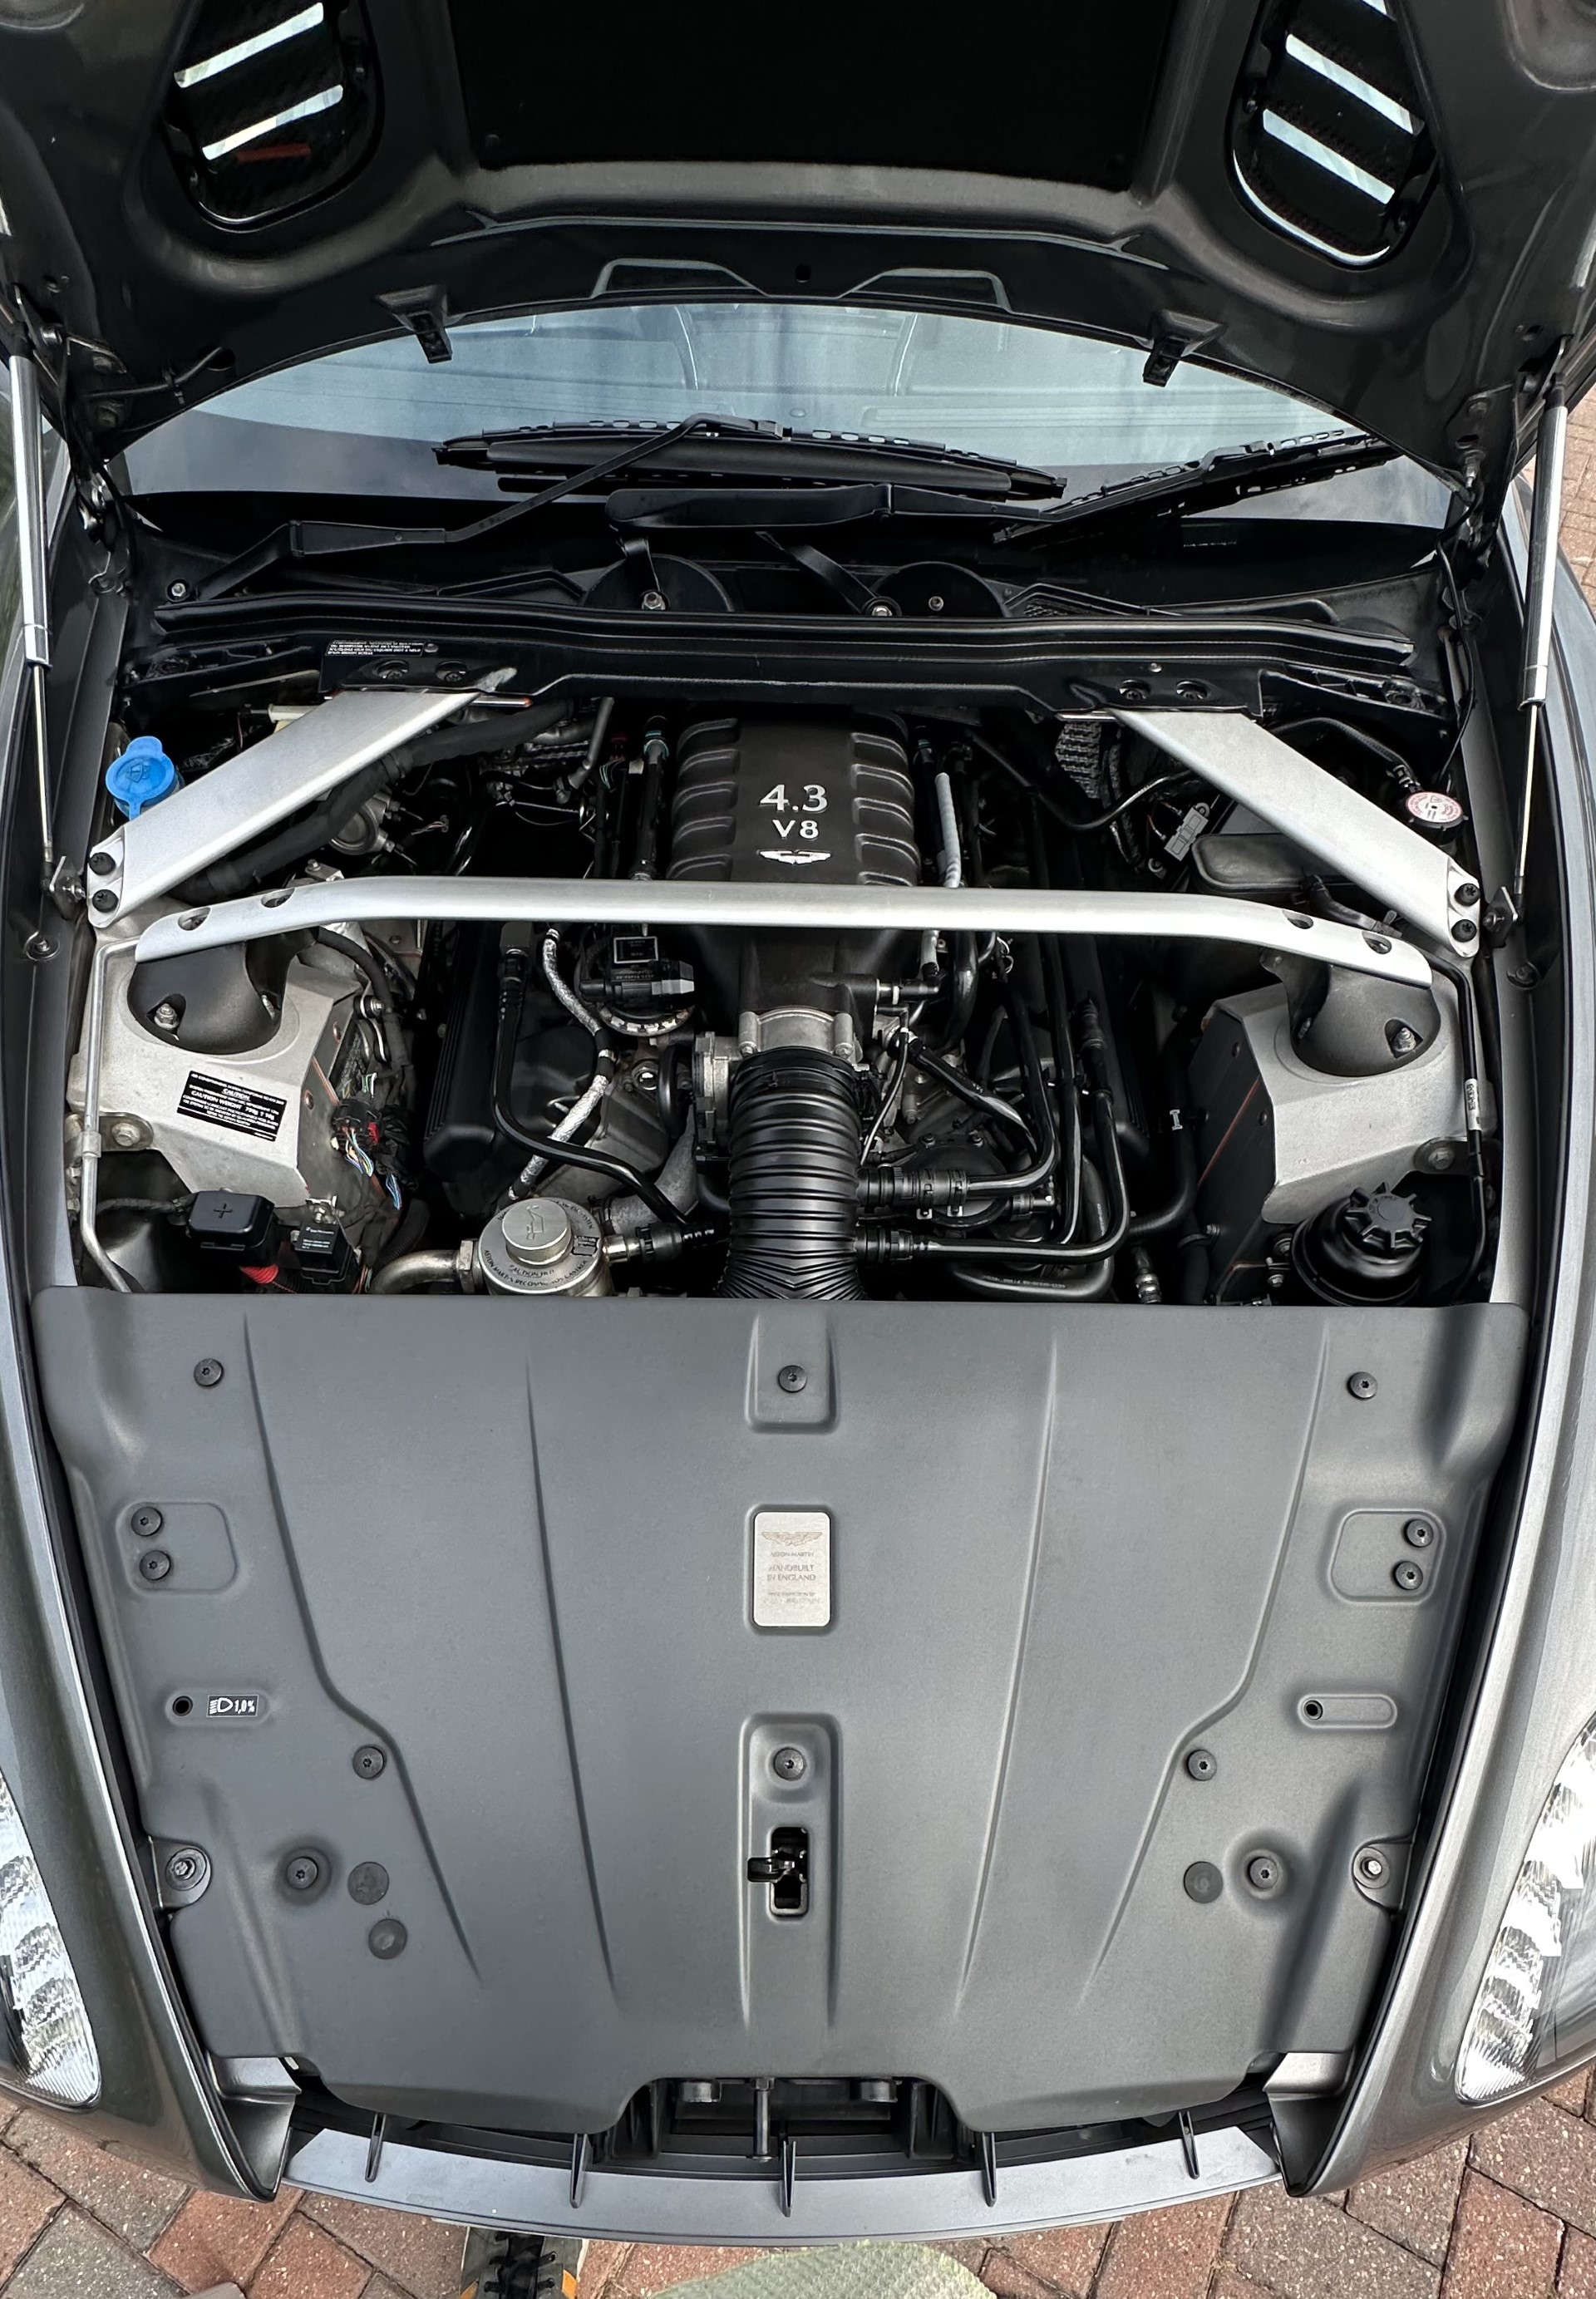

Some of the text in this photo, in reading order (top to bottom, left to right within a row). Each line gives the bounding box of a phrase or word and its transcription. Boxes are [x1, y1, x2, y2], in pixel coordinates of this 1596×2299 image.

[759, 784, 828, 813] 4.3
[772, 820, 819, 840] V8
[191, 1090, 218, 1103] CAUTION
[484, 1249, 495, 1268] ASTON
